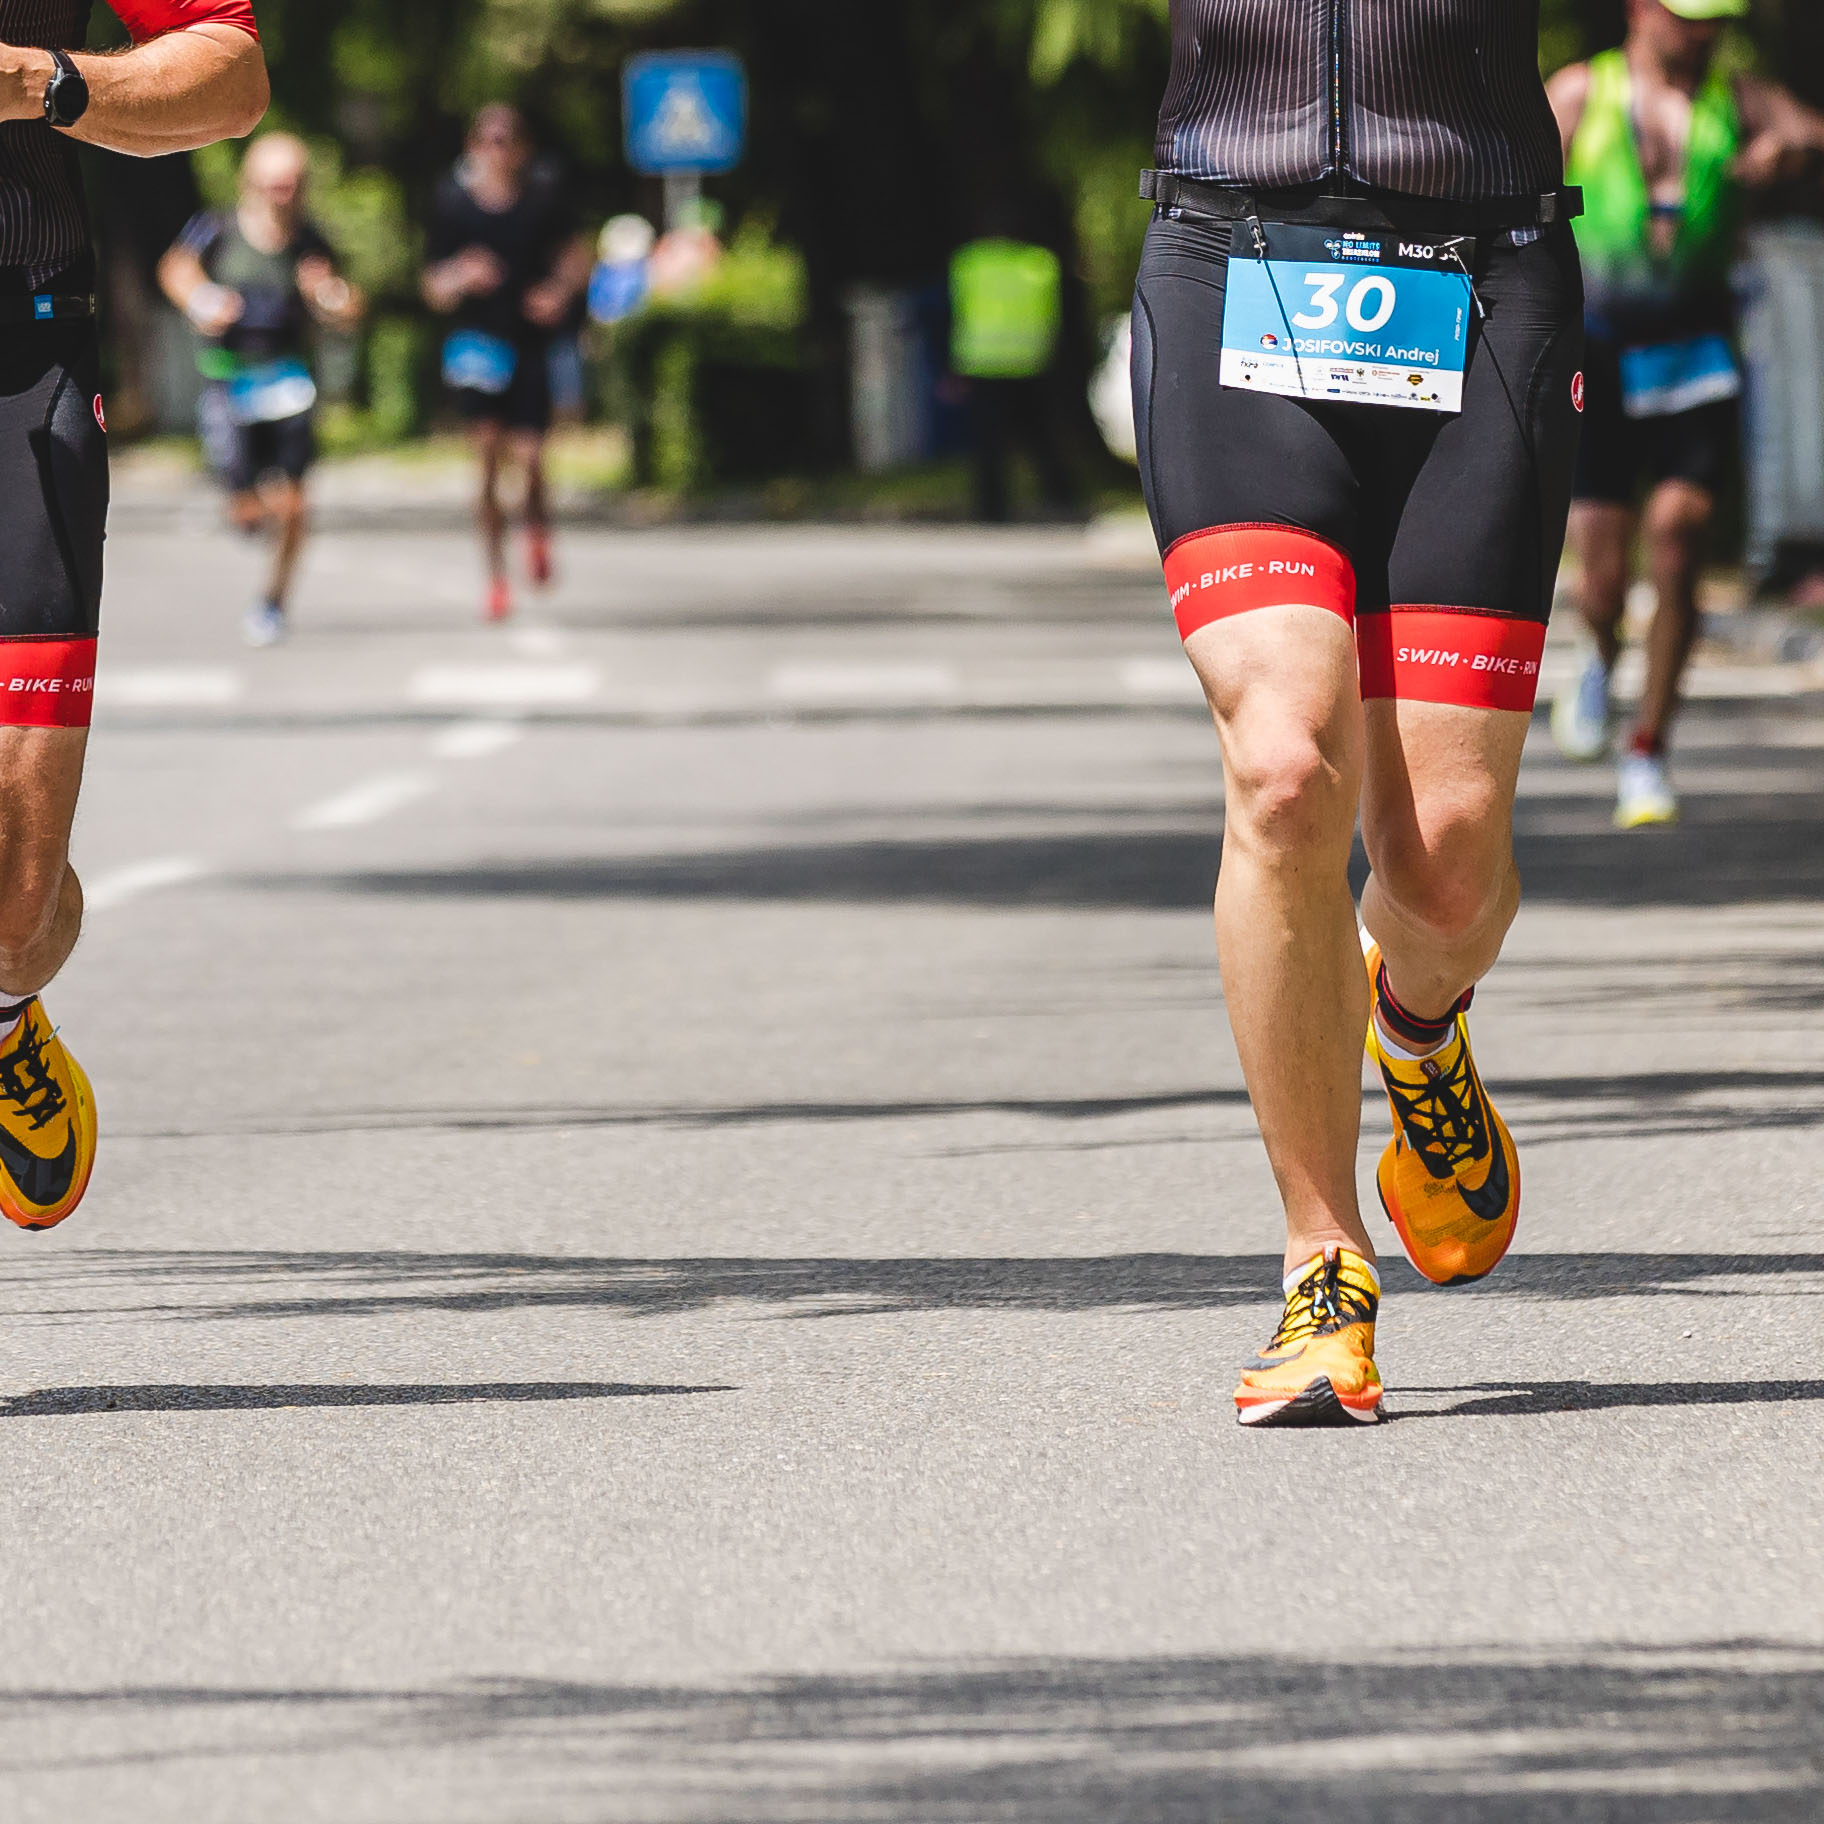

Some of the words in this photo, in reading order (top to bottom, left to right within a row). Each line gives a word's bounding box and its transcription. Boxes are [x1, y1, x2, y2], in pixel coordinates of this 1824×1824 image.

[1291, 272, 1397, 333] 30
[1281, 337, 1381, 358] JOSIFOVSKI
[1384, 345, 1440, 366] Andrej
[1200, 563, 1254, 590] BIKE
[1268, 560, 1315, 577] RUN
[1396, 647, 1460, 667] SWIM
[1471, 654, 1520, 674] BIKE
[7, 677, 63, 693] BIKE
